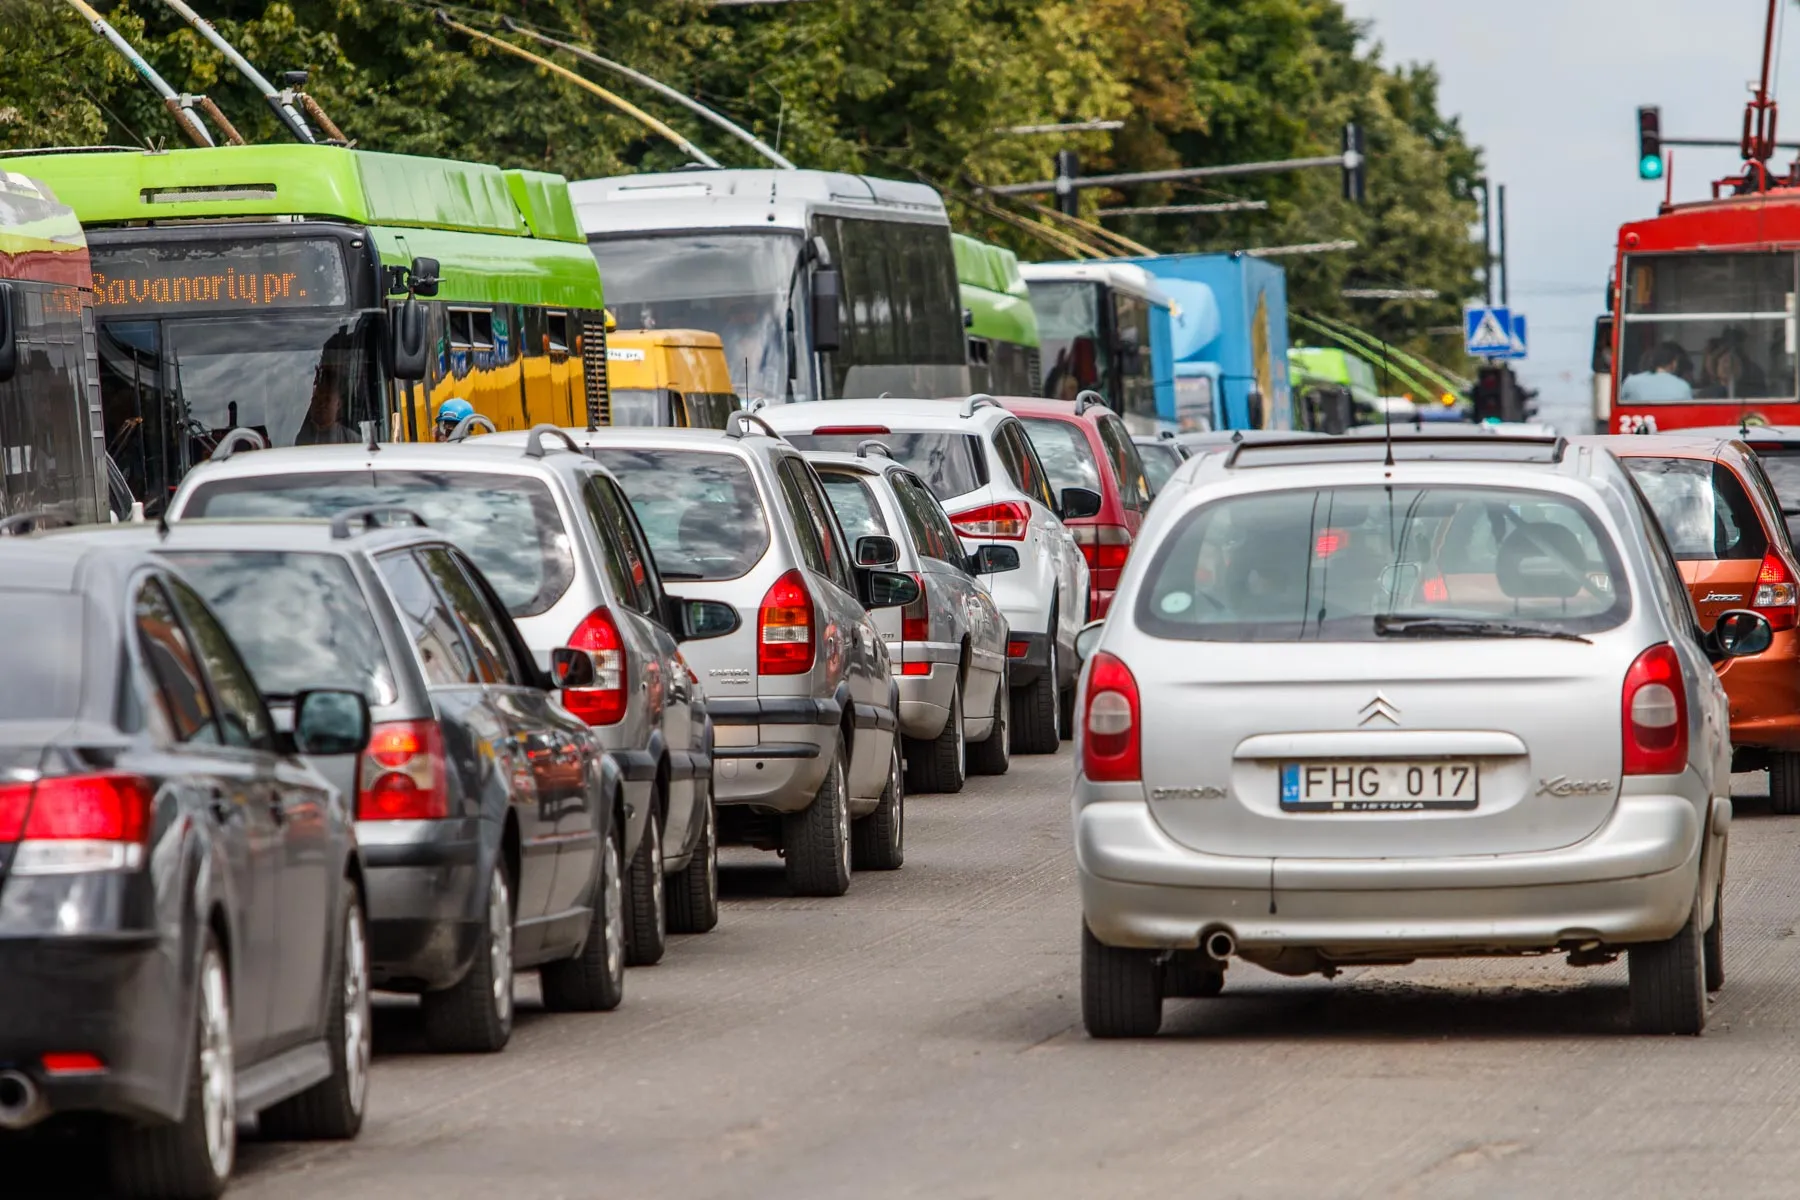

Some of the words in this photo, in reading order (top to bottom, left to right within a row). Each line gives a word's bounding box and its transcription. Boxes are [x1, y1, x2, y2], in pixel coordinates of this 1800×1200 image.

[264, 273, 306, 302] pr.
[1283, 786, 1298, 797] LT
[1305, 767, 1379, 797] FHG
[1407, 767, 1469, 797] 017
[1352, 802, 1424, 810] LIETUVA
